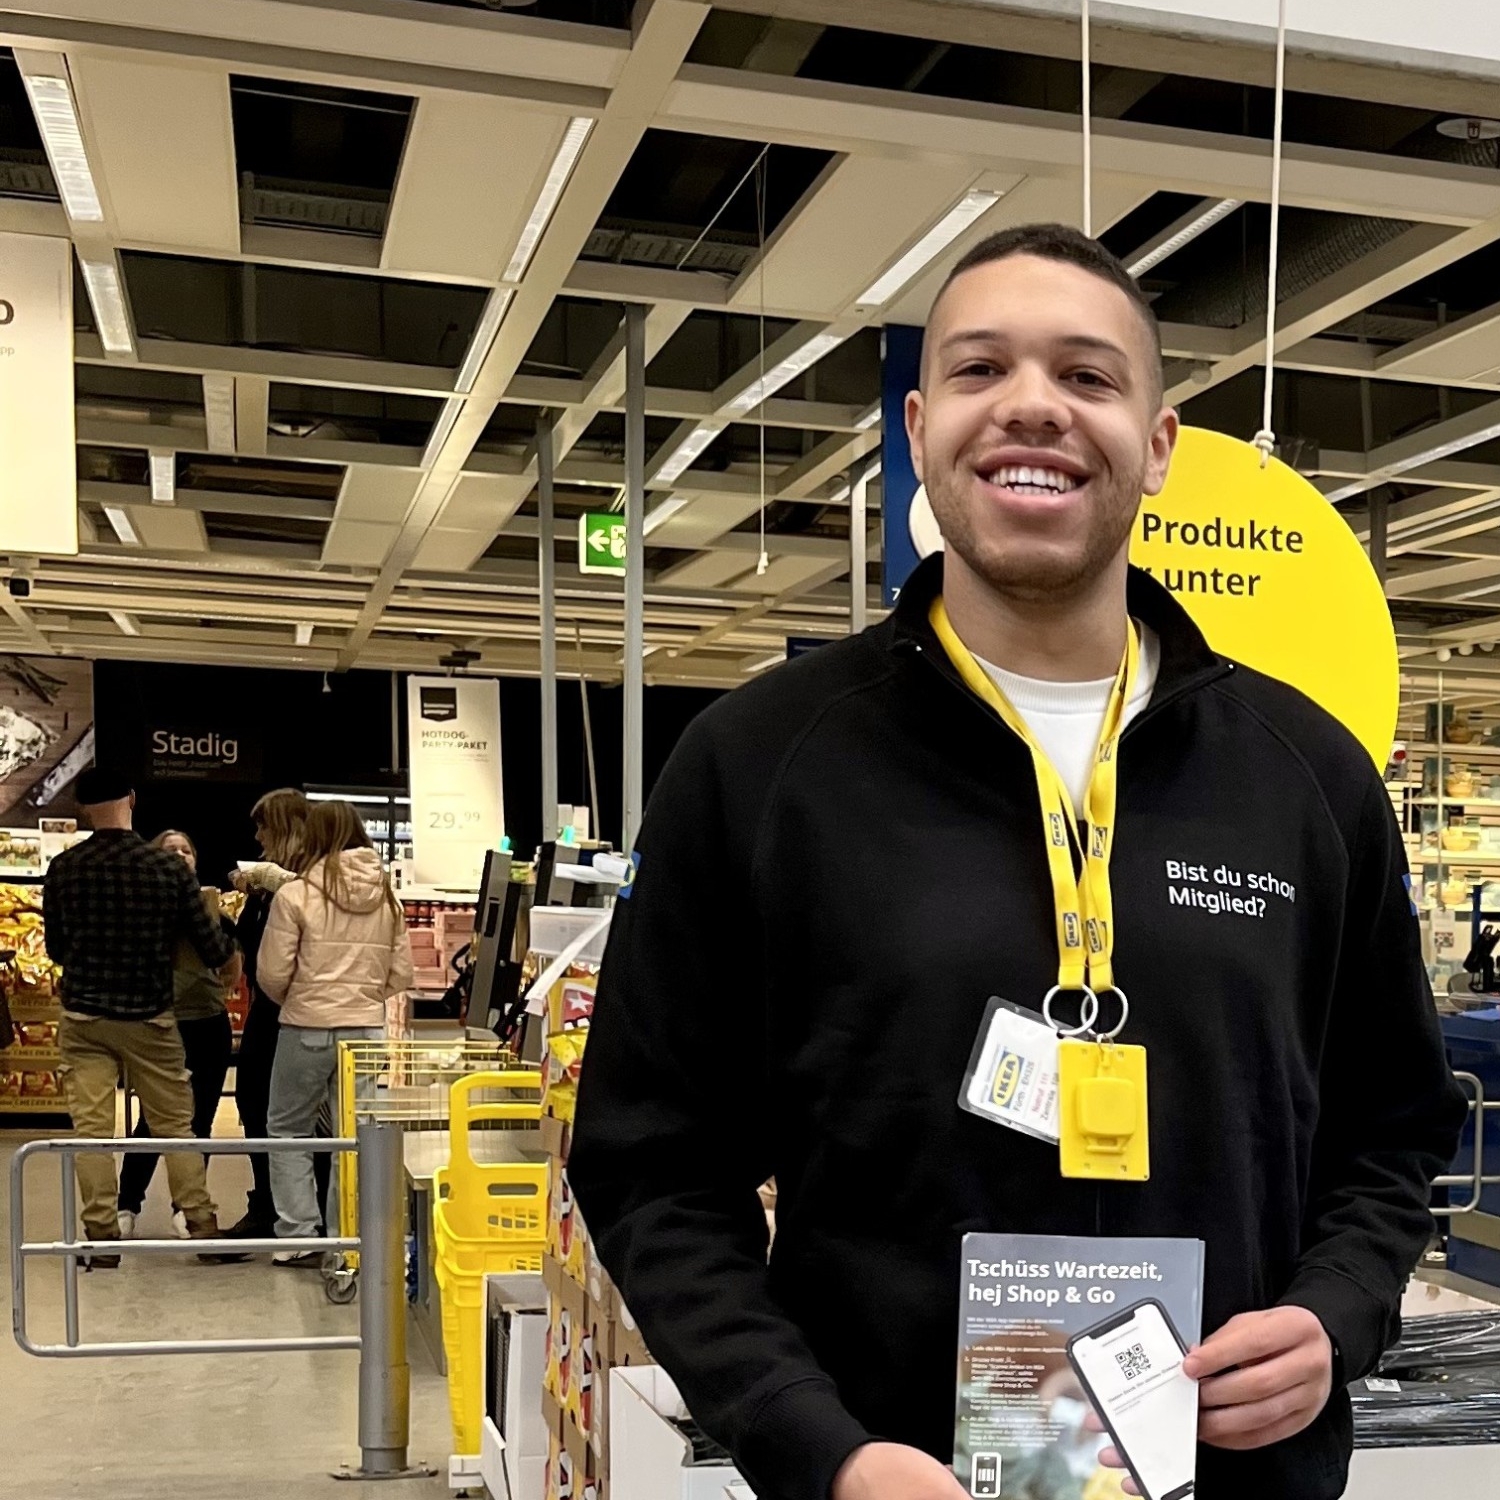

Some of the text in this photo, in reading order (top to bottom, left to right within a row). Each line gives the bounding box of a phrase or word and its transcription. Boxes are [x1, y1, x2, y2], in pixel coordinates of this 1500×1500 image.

[1143, 513, 1302, 553] Produkte
[1164, 568, 1260, 597] unter
[152, 730, 238, 764] Stadig
[421, 731, 470, 740] HOTDOG-
[421, 740, 488, 750] PARTY-PAKET
[1166, 860, 1209, 883] Bist
[1213, 864, 1241, 887] du
[1168, 885, 1266, 918] Mitglied?
[997, 1060, 1016, 1100] IKEA
[967, 1259, 1163, 1281] Tschüss Wartezeit,
[968, 1284, 1116, 1307] hej Shop & Go
